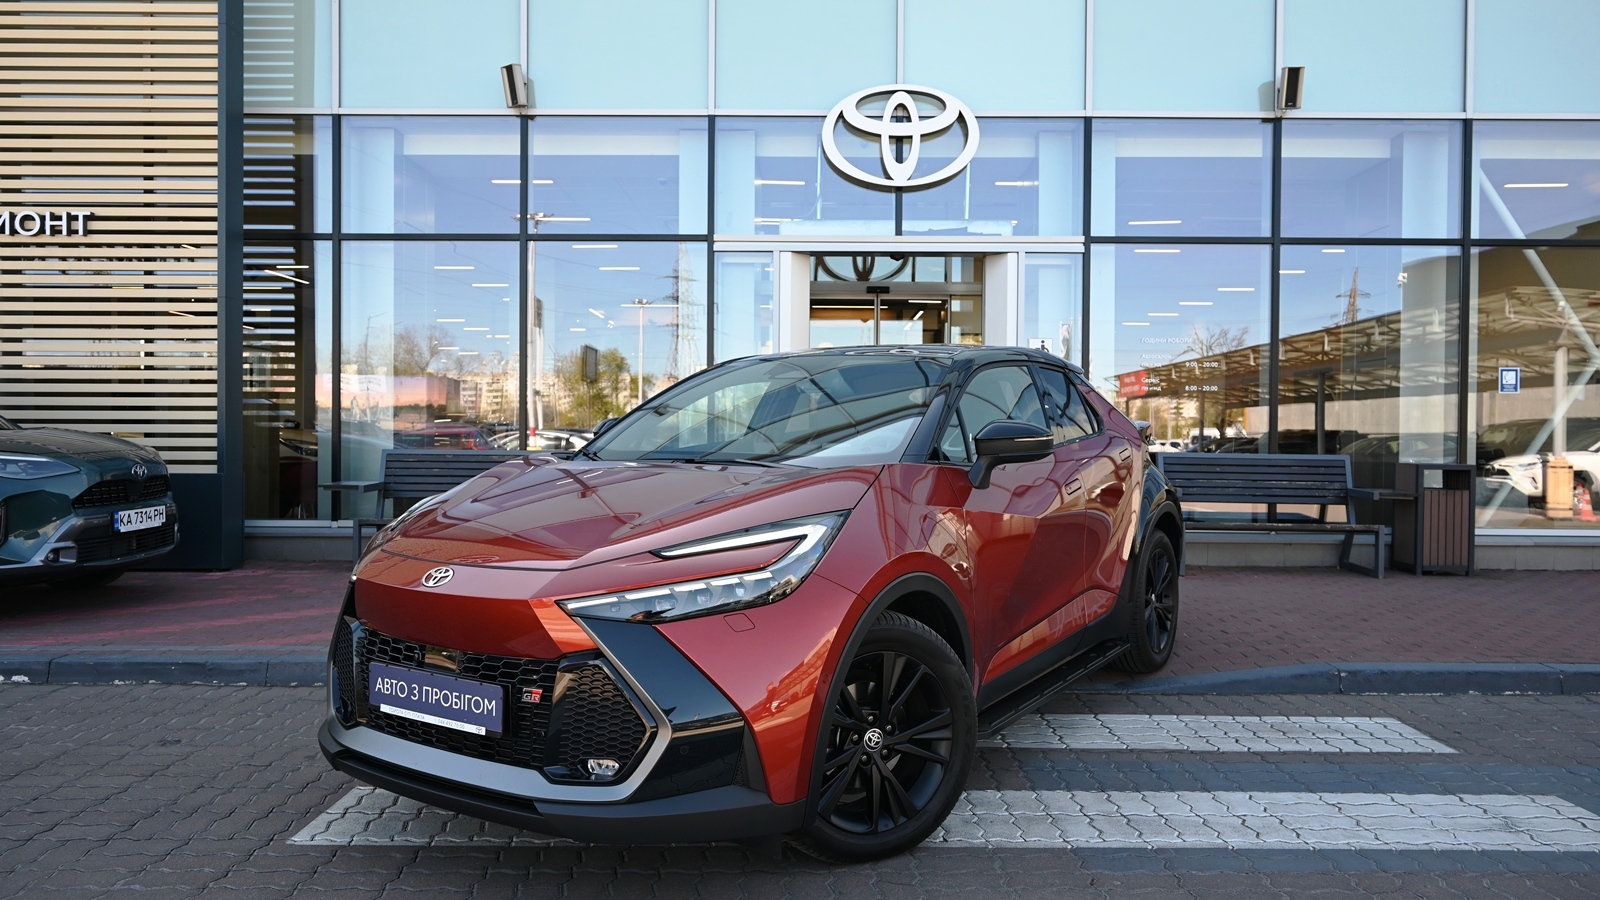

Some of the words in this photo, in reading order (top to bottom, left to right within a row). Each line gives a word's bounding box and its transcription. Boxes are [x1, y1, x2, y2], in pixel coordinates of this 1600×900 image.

[134, 510, 153, 525] 7314
[375, 677, 408, 698] АВТО
[422, 686, 496, 717] ПРОБІГОМ
[523, 693, 541, 701] GR
